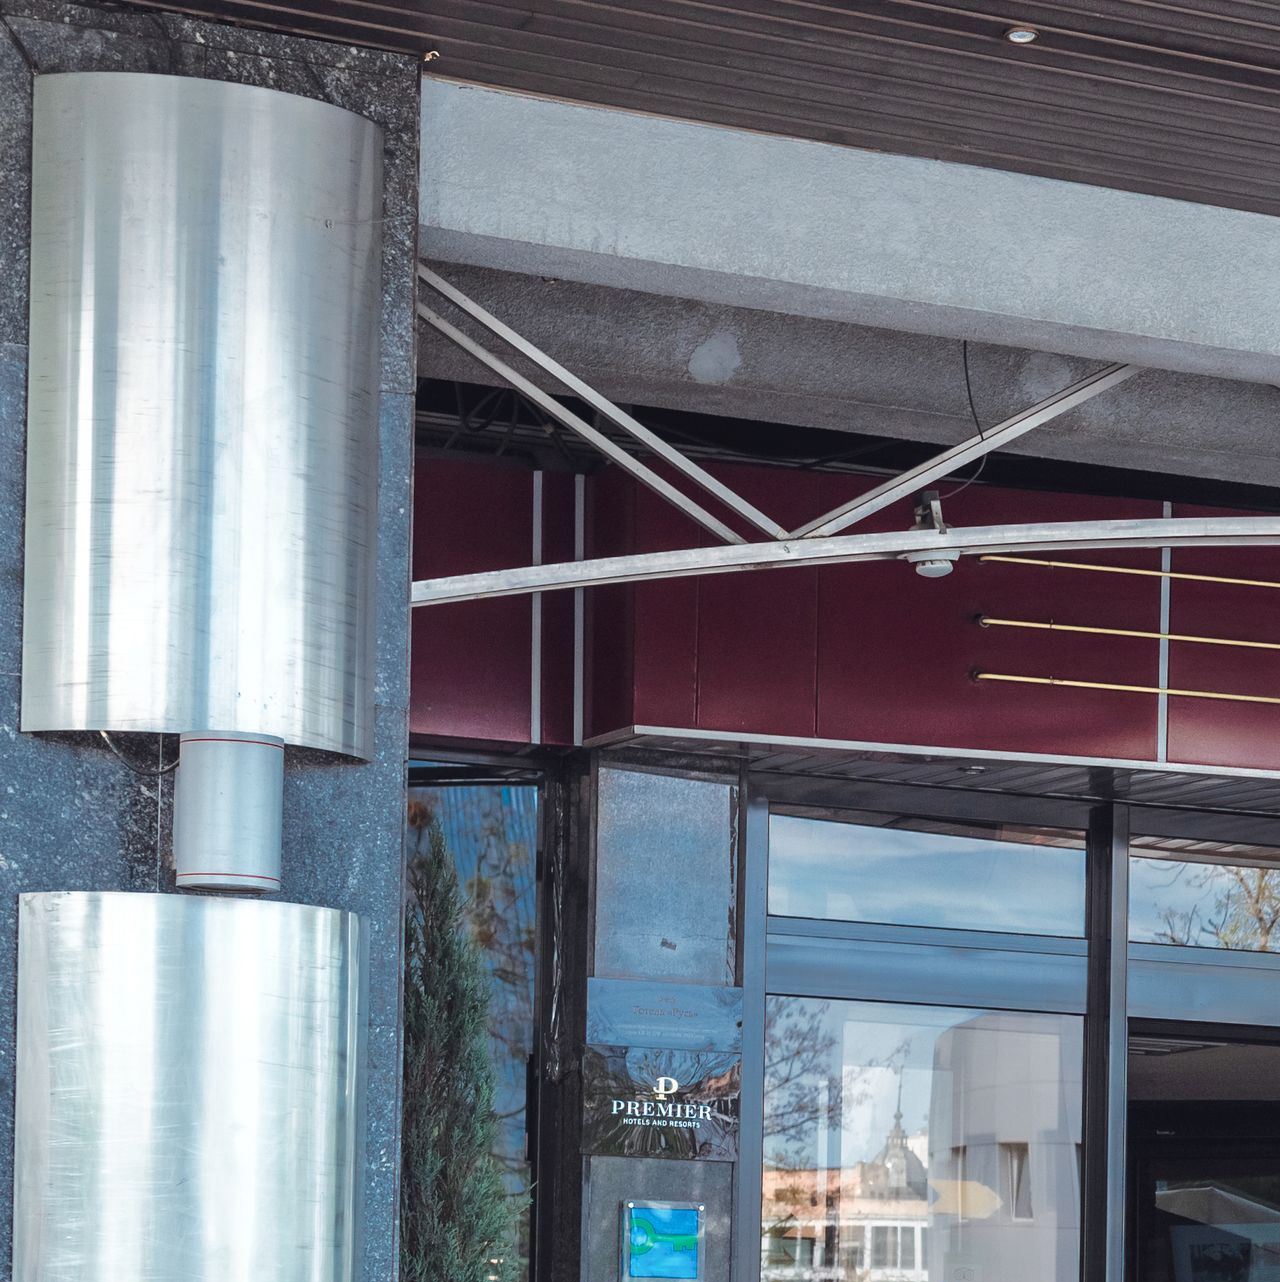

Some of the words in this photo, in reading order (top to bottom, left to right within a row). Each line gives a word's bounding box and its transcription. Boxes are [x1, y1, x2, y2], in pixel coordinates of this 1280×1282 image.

[611, 1100, 712, 1121] PREMIER
[622, 1118, 650, 1126] HOTELS
[652, 1119, 668, 1127] AND
[669, 1120, 700, 1129] RESORTS
